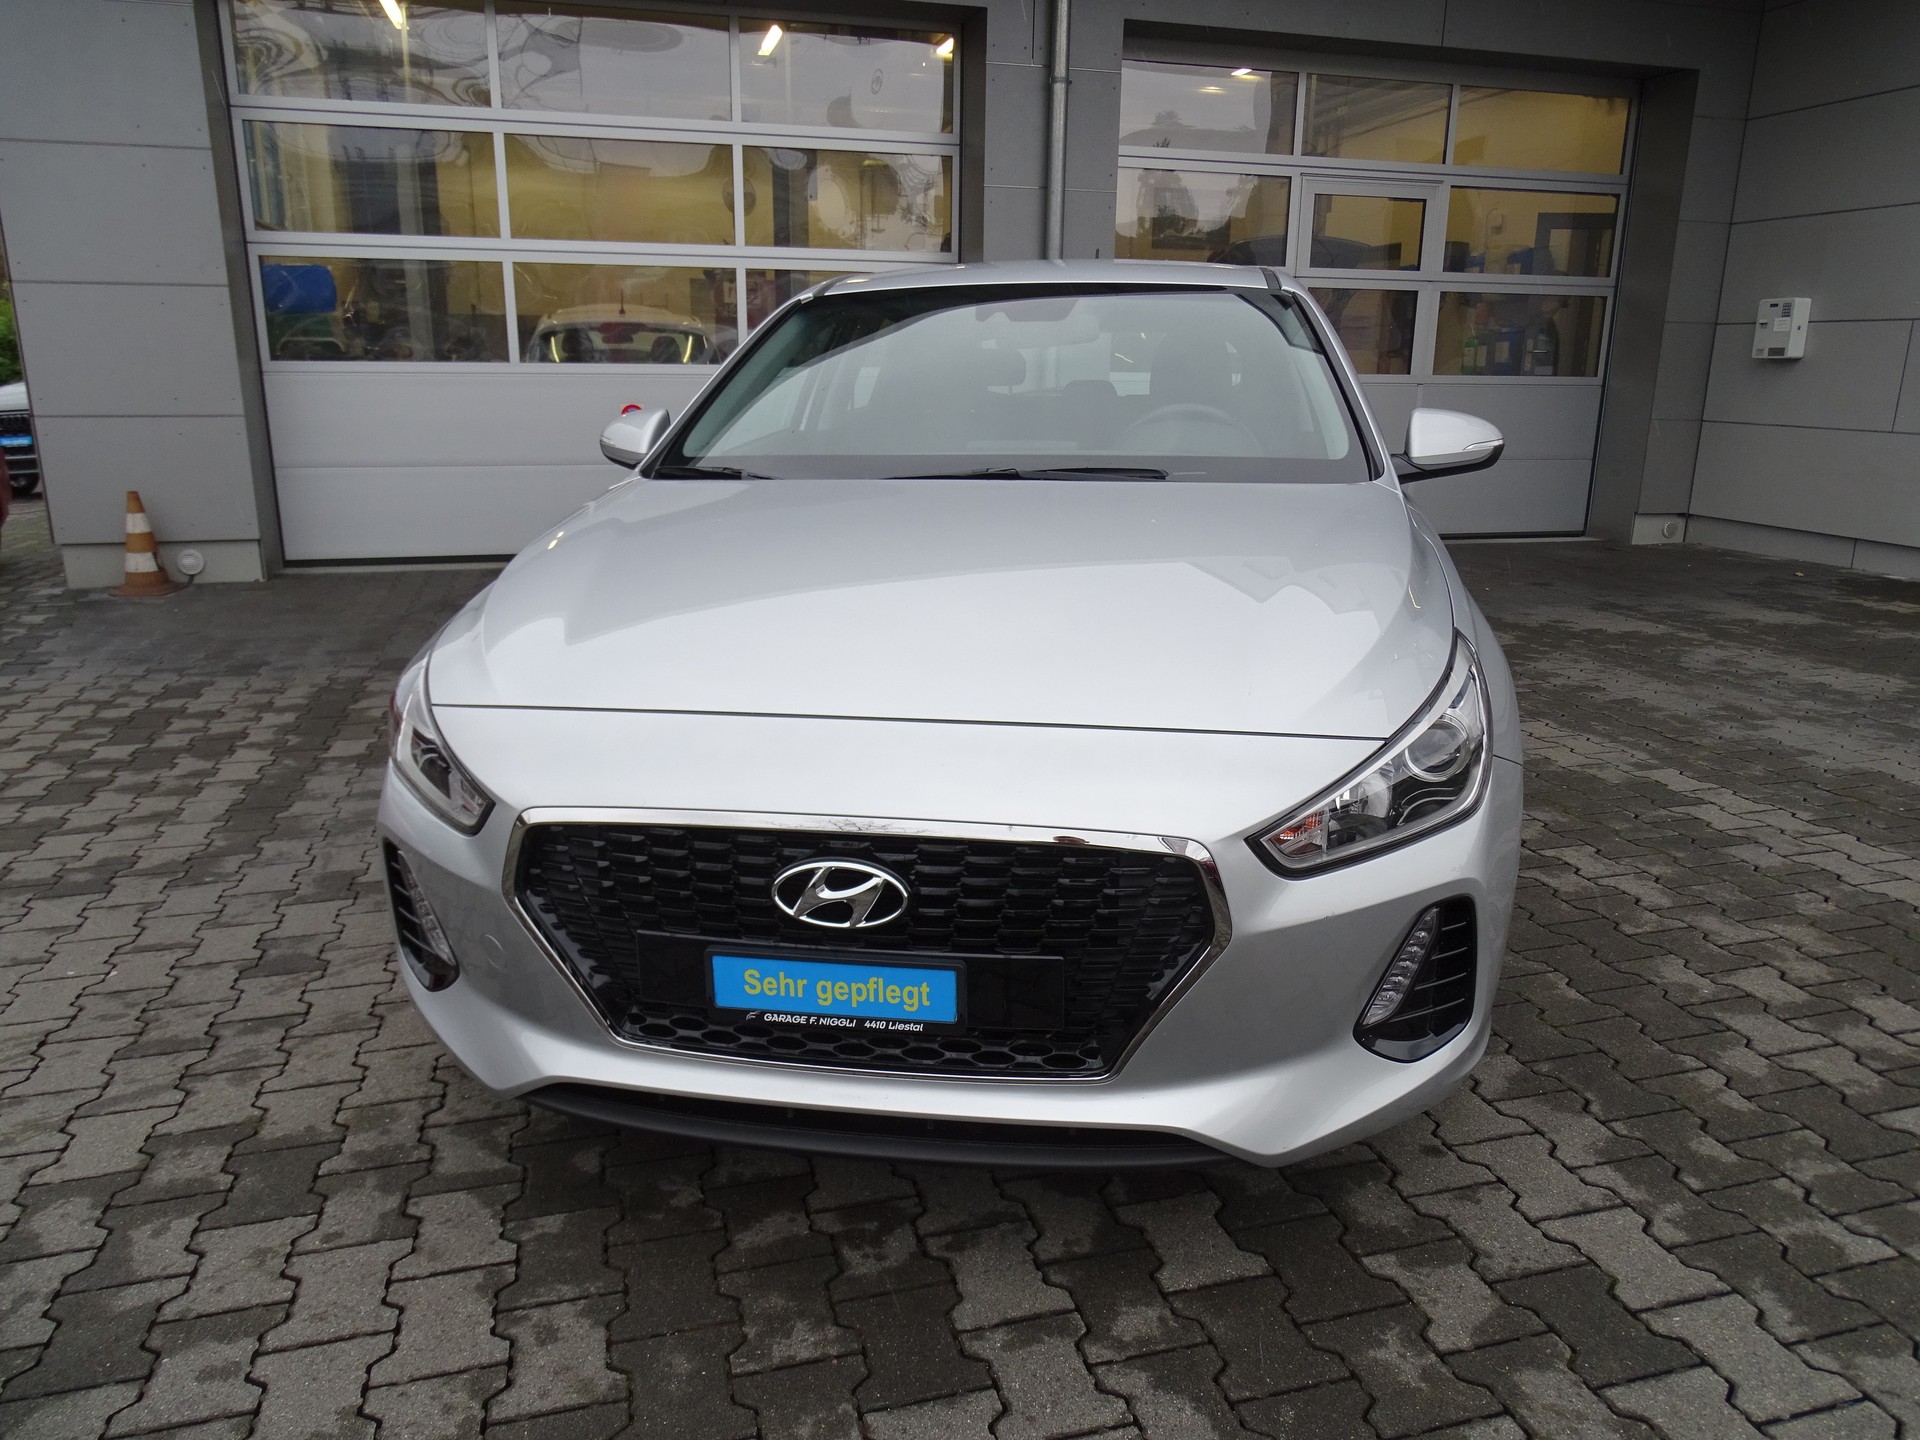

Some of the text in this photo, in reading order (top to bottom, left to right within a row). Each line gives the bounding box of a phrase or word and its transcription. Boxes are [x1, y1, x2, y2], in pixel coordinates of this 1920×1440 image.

[744, 969, 930, 1011] Sehr gepflegt
[763, 1013, 807, 1023] GARAGE
[818, 1017, 856, 1027] NIGGLI
[863, 1019, 886, 1029] 4410
[888, 1021, 924, 1032] Liestal
